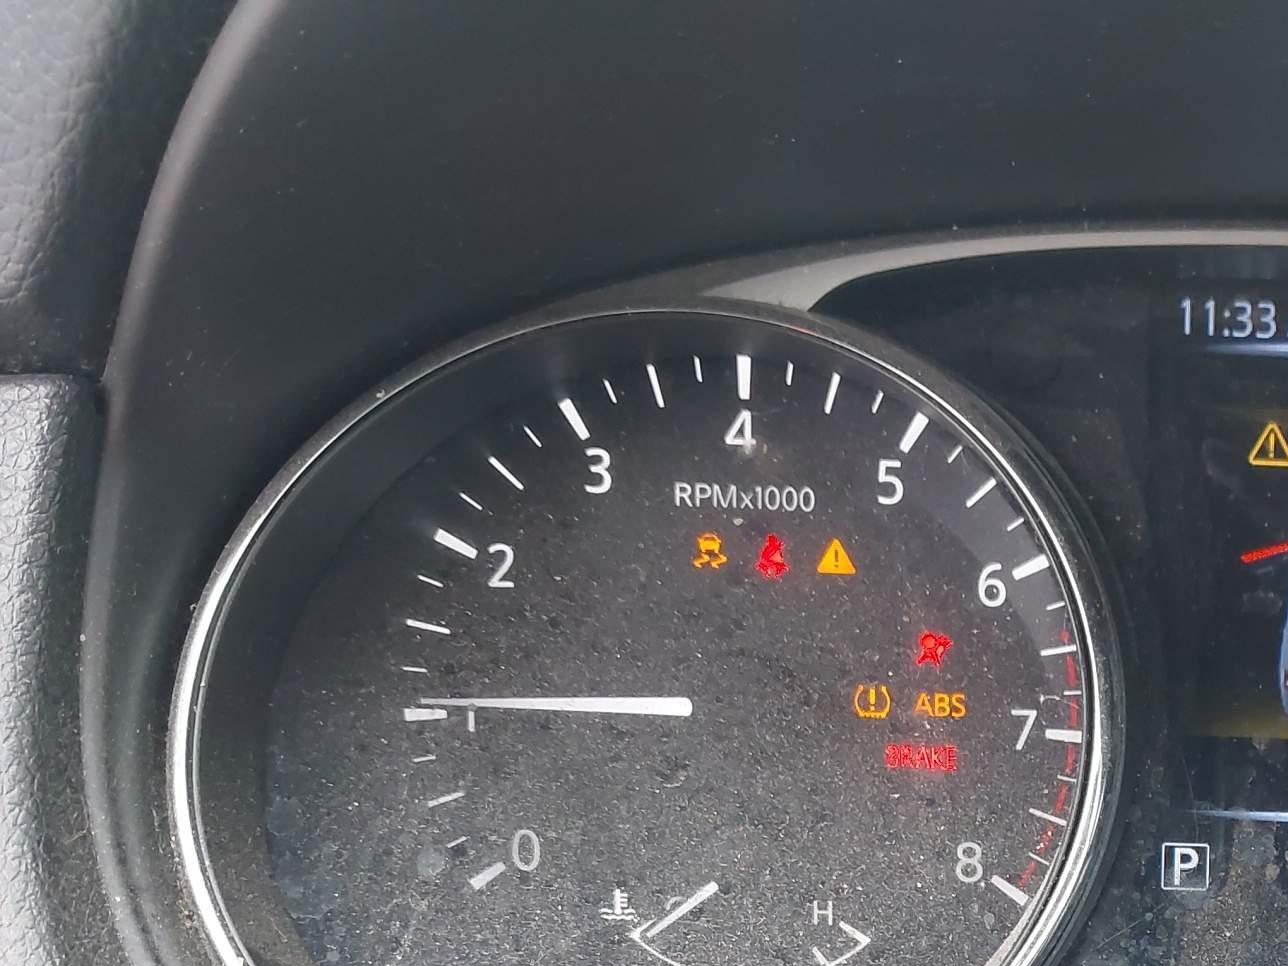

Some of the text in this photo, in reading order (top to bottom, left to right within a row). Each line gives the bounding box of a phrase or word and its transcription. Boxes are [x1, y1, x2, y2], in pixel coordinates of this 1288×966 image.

[1180, 297, 1277, 339] 11:33
[725, 409, 754, 447] 4
[584, 448, 611, 494] 3
[878, 459, 902, 505] 5
[674, 482, 815, 512] RPMx1000
[488, 544, 514, 588] 2
[978, 563, 1005, 606] 6
[914, 692, 966, 718] ABS
[1011, 709, 1037, 750] 7
[886, 744, 957, 771] BRAKE
[512, 829, 541, 871] 0
[956, 841, 983, 884] 8
[1174, 847, 1198, 886] P
[813, 901, 833, 926] H
